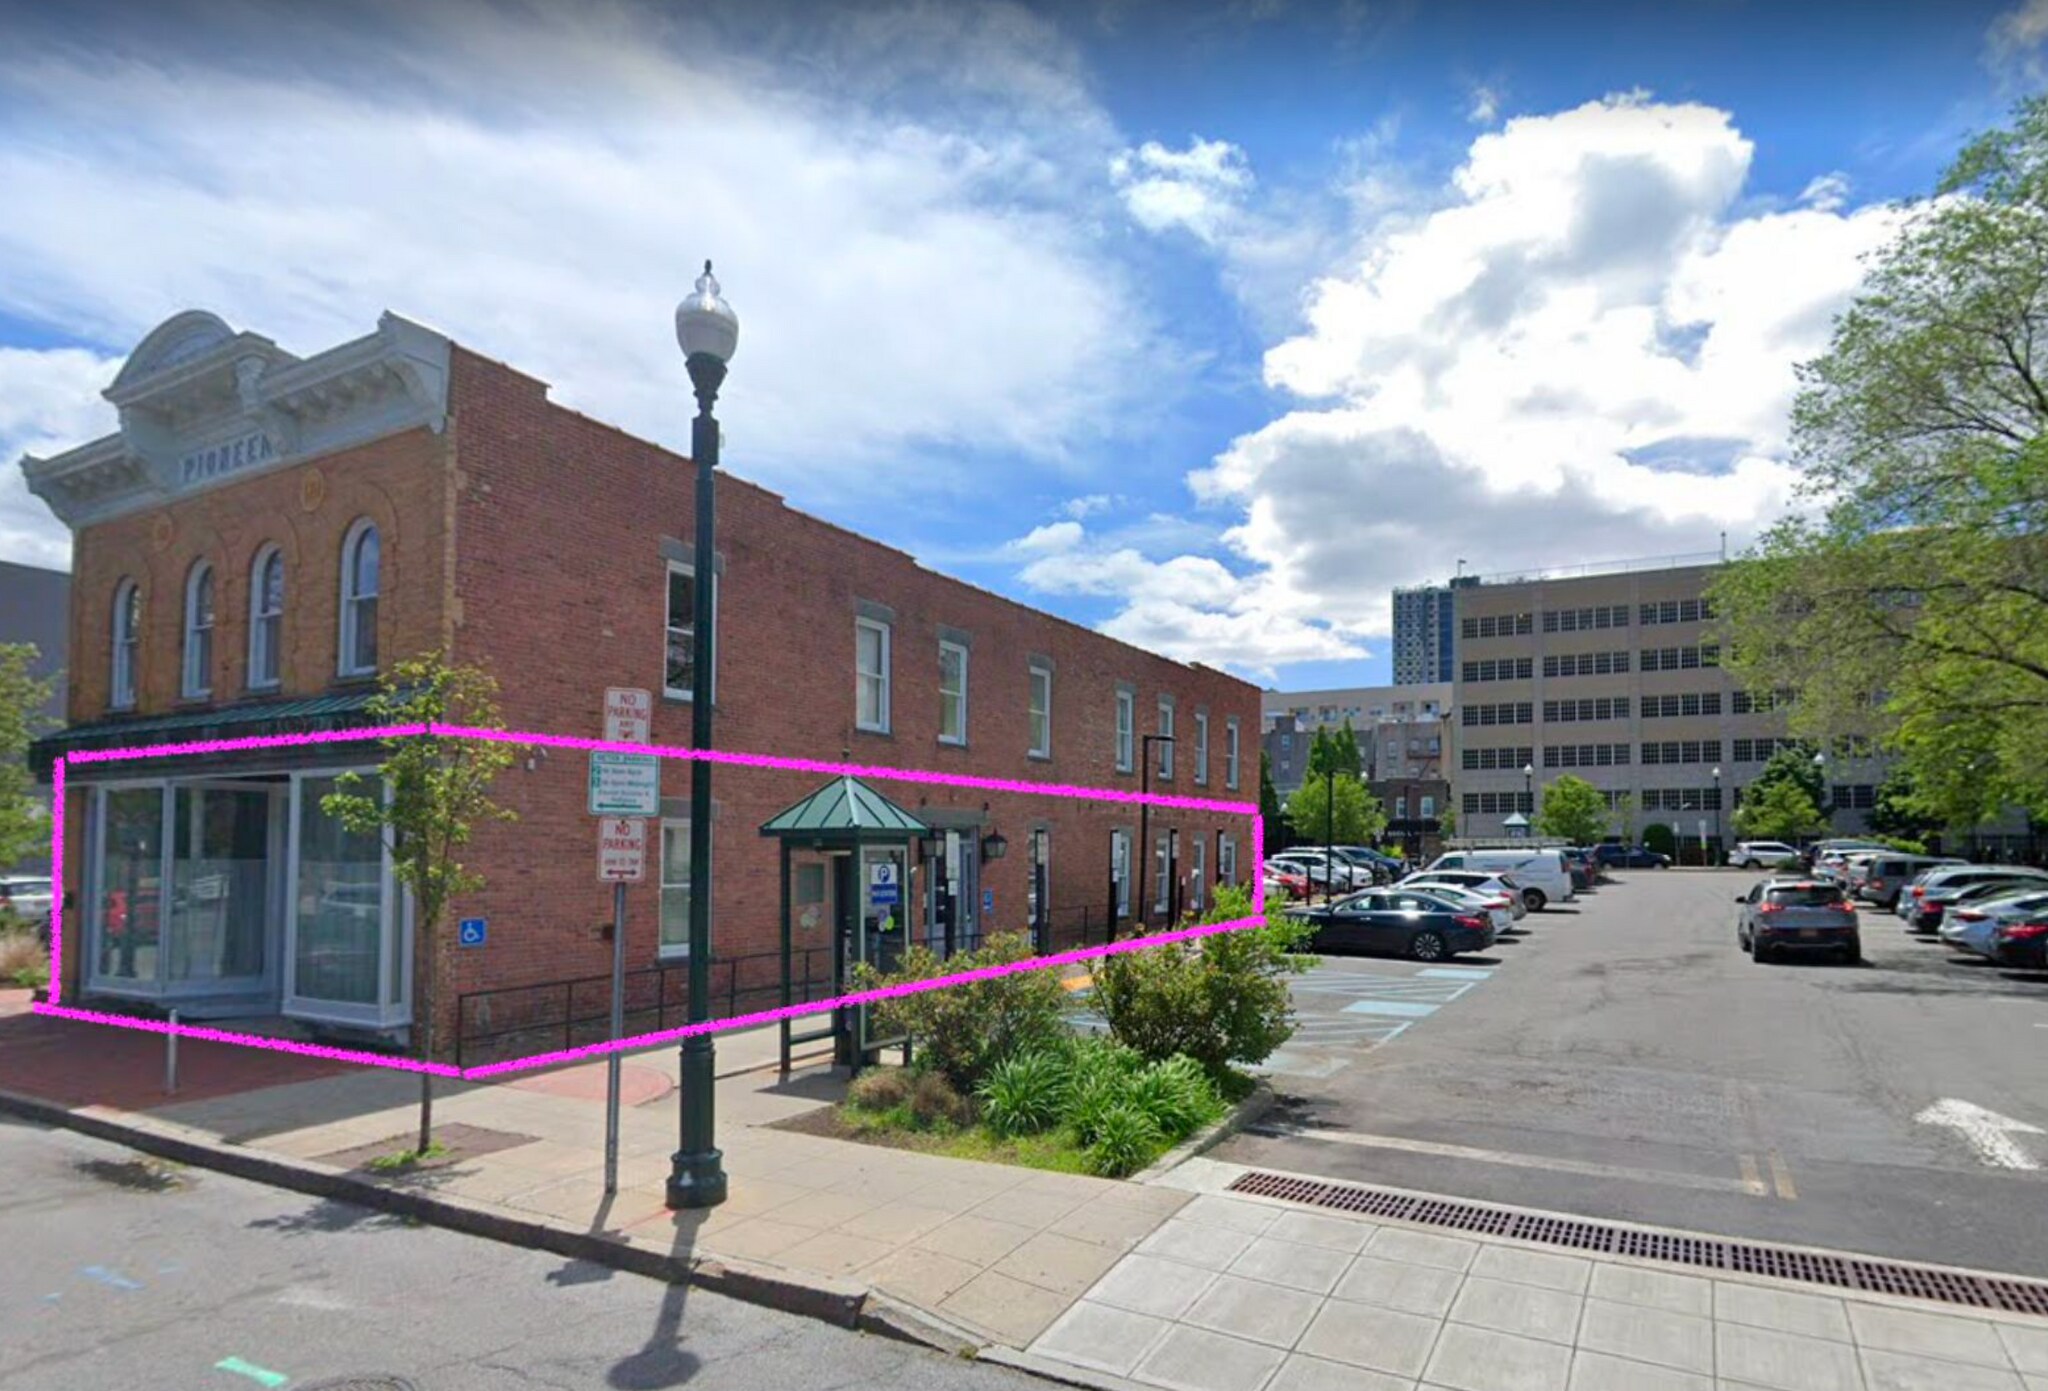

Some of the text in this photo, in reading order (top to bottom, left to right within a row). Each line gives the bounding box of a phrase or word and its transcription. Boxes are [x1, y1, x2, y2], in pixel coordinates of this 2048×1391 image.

[619, 693, 637, 706] NO
[608, 705, 647, 721] PARKING
[615, 823, 631, 837] NO
[602, 838, 641, 851] PARKING
